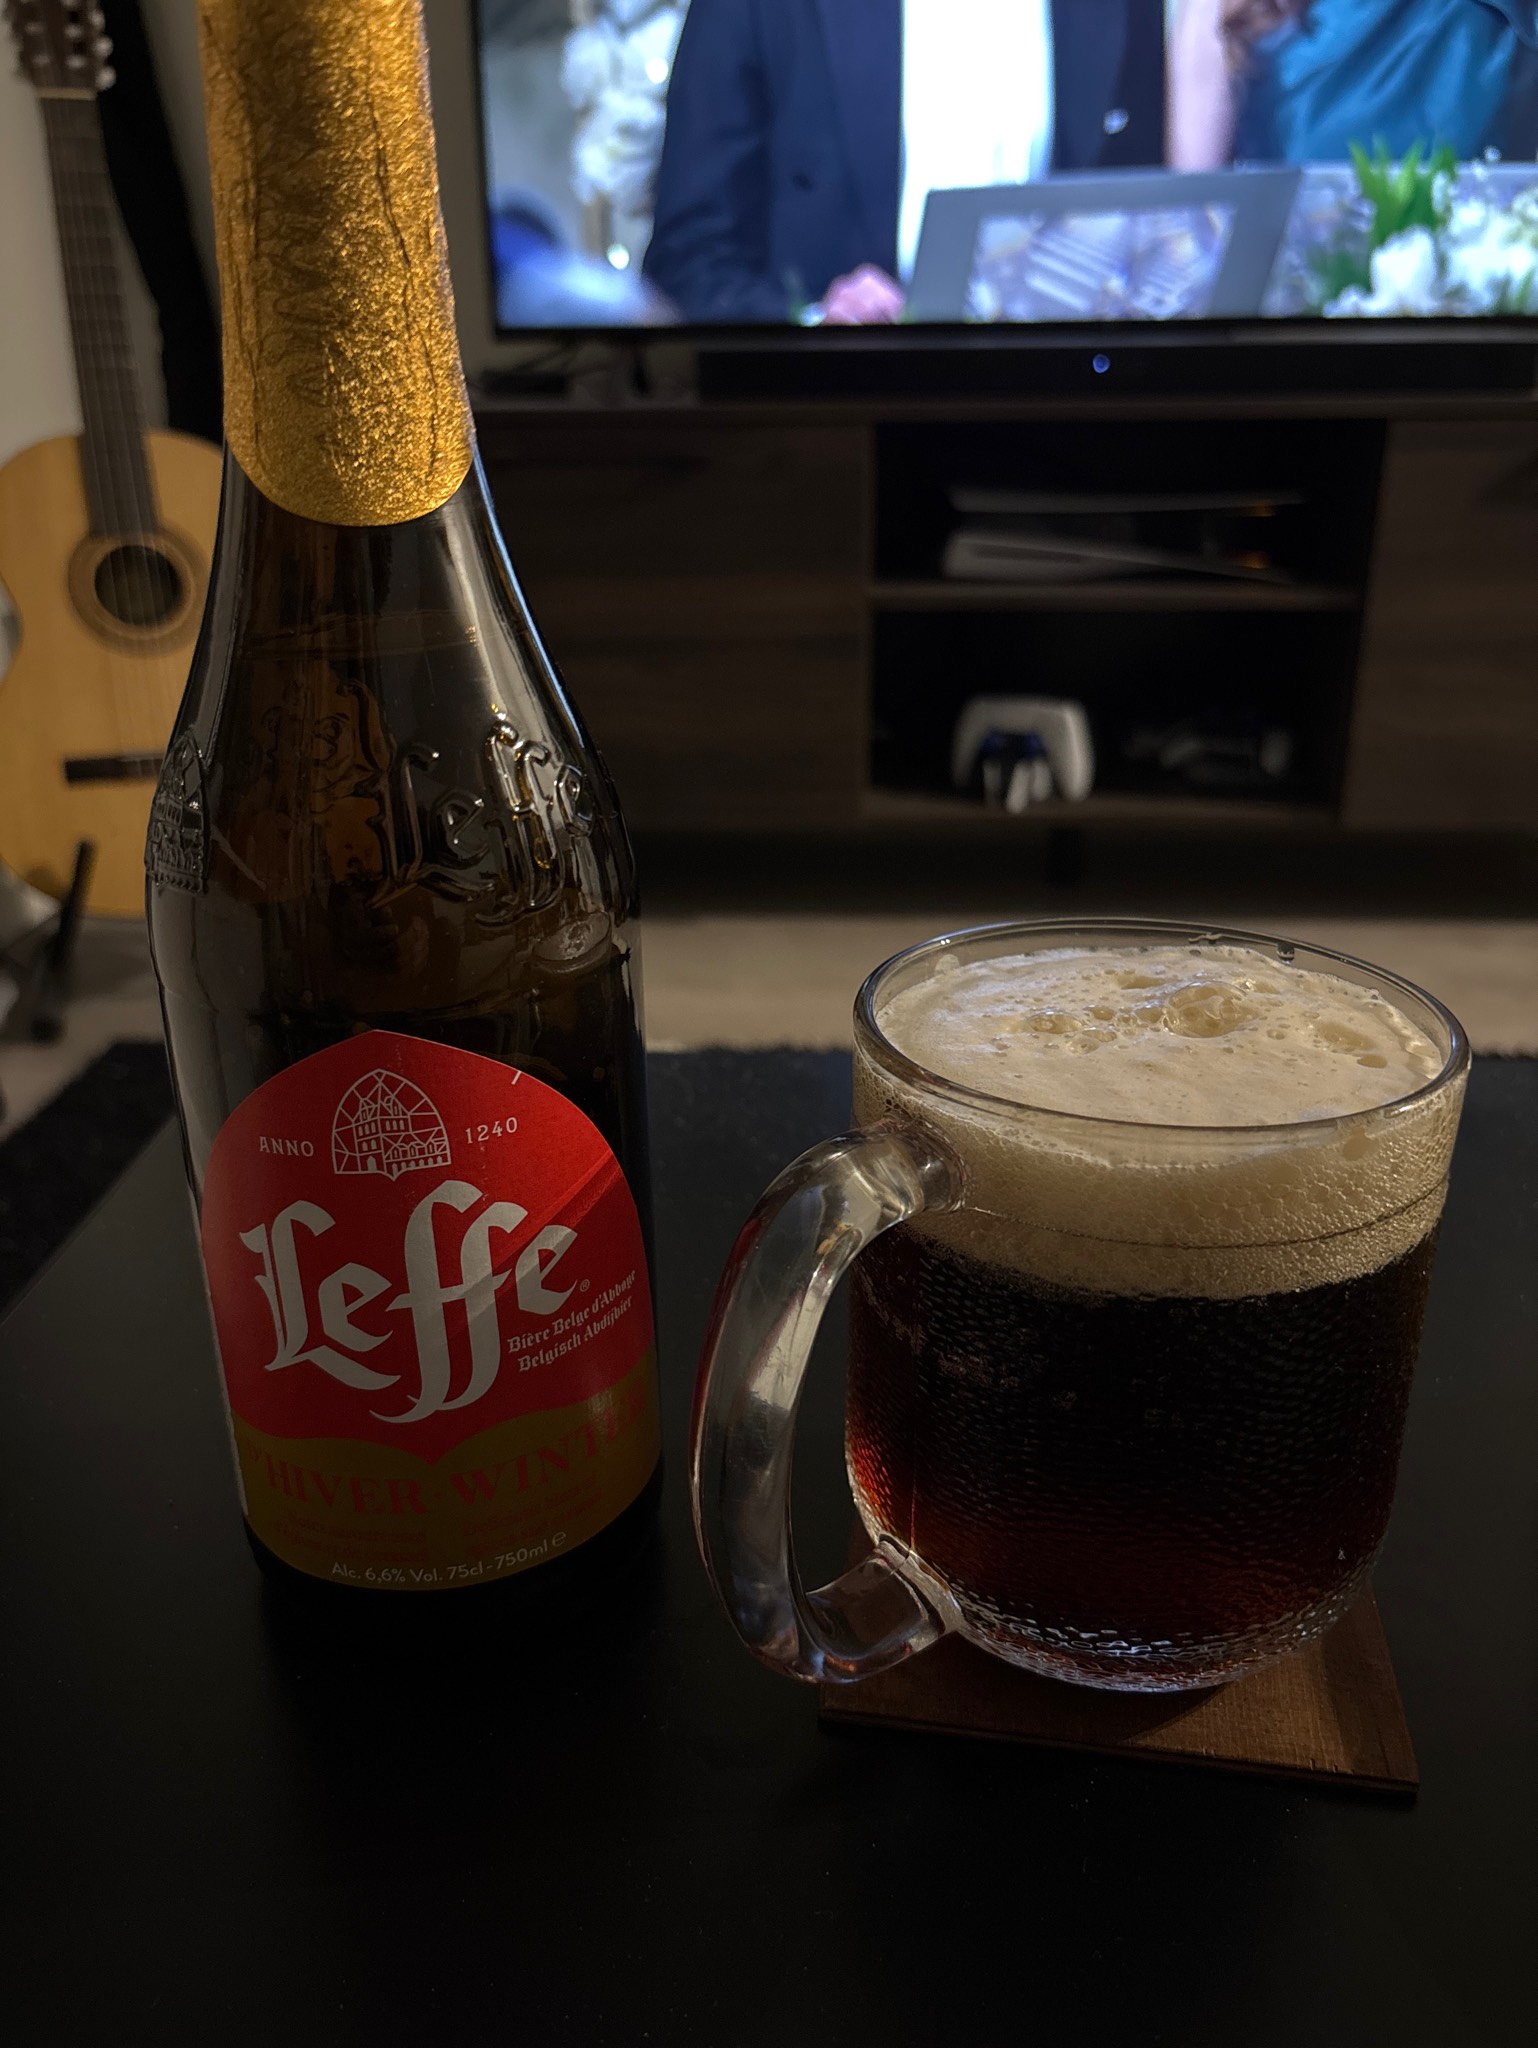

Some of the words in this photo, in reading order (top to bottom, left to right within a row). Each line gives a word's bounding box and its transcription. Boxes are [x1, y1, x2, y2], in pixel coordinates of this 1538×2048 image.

[258, 1135, 315, 1158] ANNO
[465, 1116, 518, 1145] 1240
[239, 1179, 579, 1424] Leffe
[507, 1328, 550, 1353] Bière
[551, 1307, 590, 1336] Belge
[517, 1332, 582, 1372] Belgisch
[584, 1295, 632, 1342] Abdijbier
[331, 1561, 361, 1579] Alc.
[365, 1566, 405, 1583] 6,6%
[409, 1567, 443, 1583] Vol.
